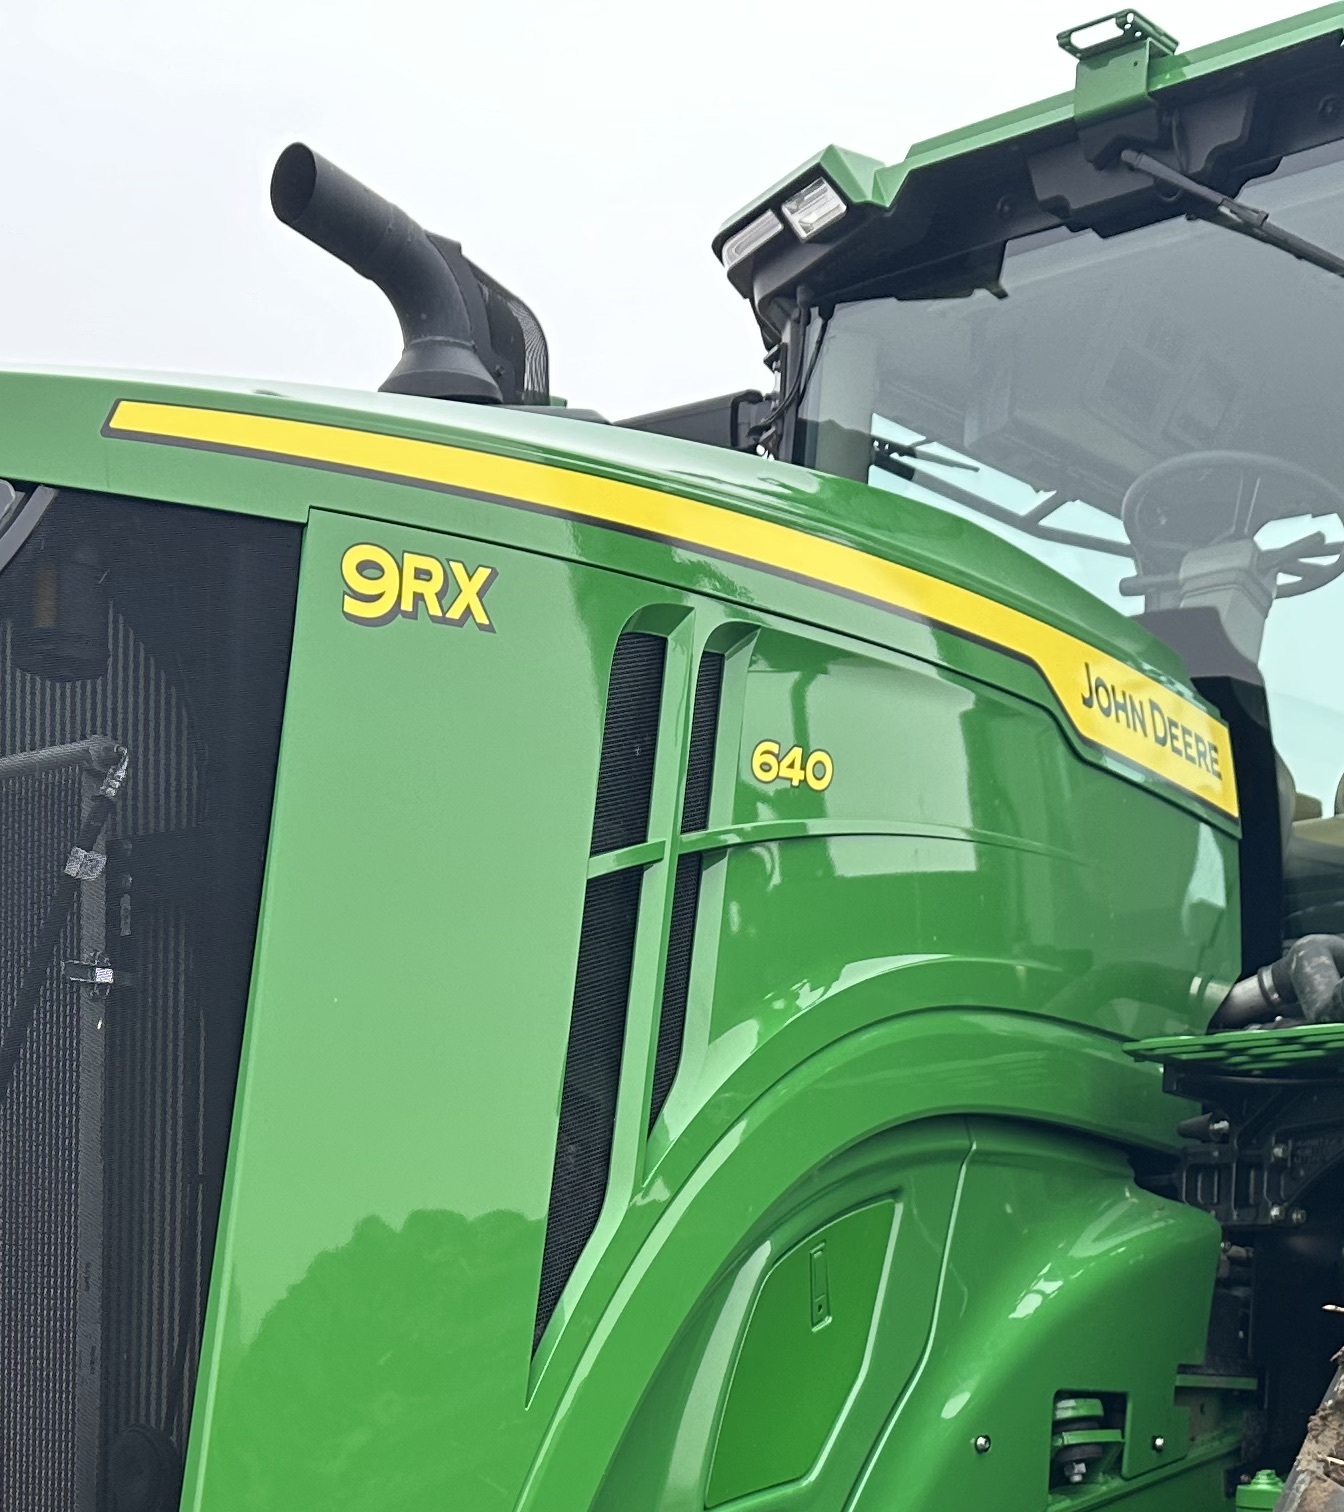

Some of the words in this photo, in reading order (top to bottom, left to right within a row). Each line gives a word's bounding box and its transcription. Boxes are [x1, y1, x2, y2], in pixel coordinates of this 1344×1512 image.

[340, 543, 498, 632] 9RX
[751, 741, 833, 791] 640
[1081, 662, 1148, 738] JOHN
[1149, 698, 1222, 781] DEERE
